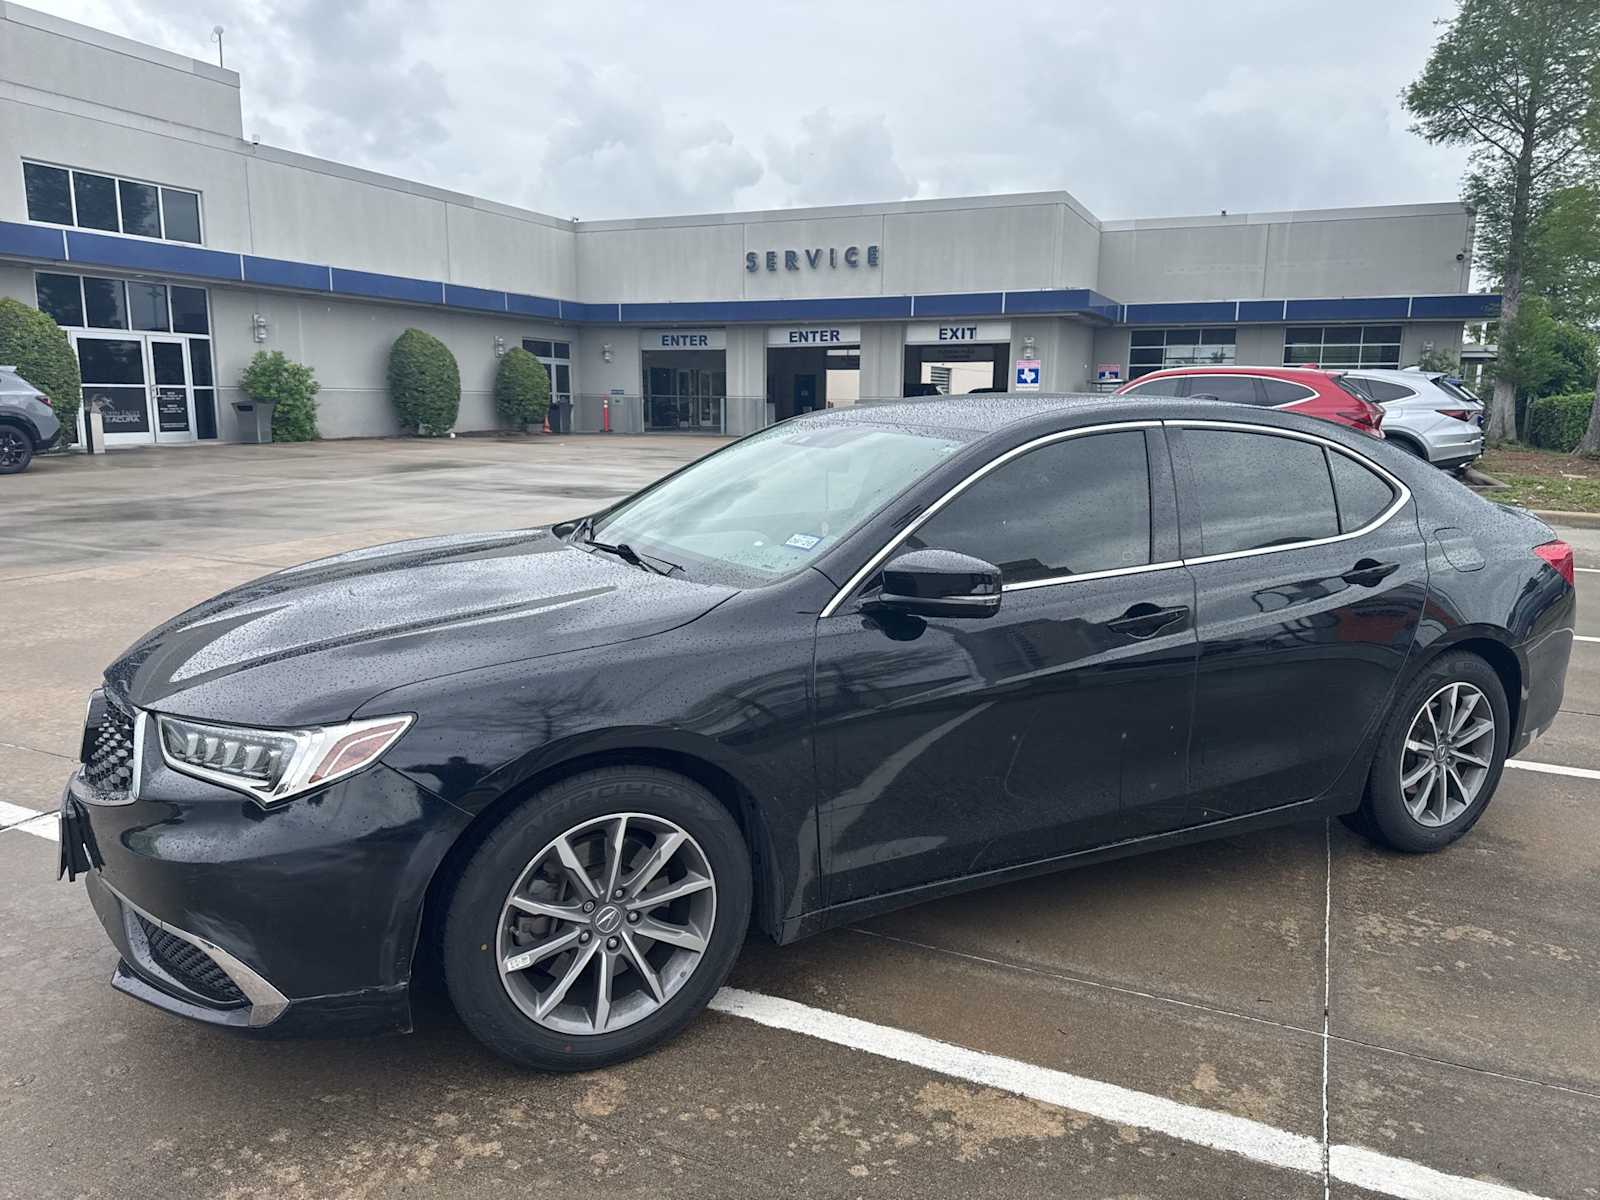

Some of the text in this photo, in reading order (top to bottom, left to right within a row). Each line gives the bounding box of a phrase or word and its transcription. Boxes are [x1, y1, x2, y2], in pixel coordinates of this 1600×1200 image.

[745, 246, 880, 273] SERVICE
[788, 329, 841, 343] ENTER
[939, 326, 977, 340] EXIT
[661, 334, 709, 347] ENTER
